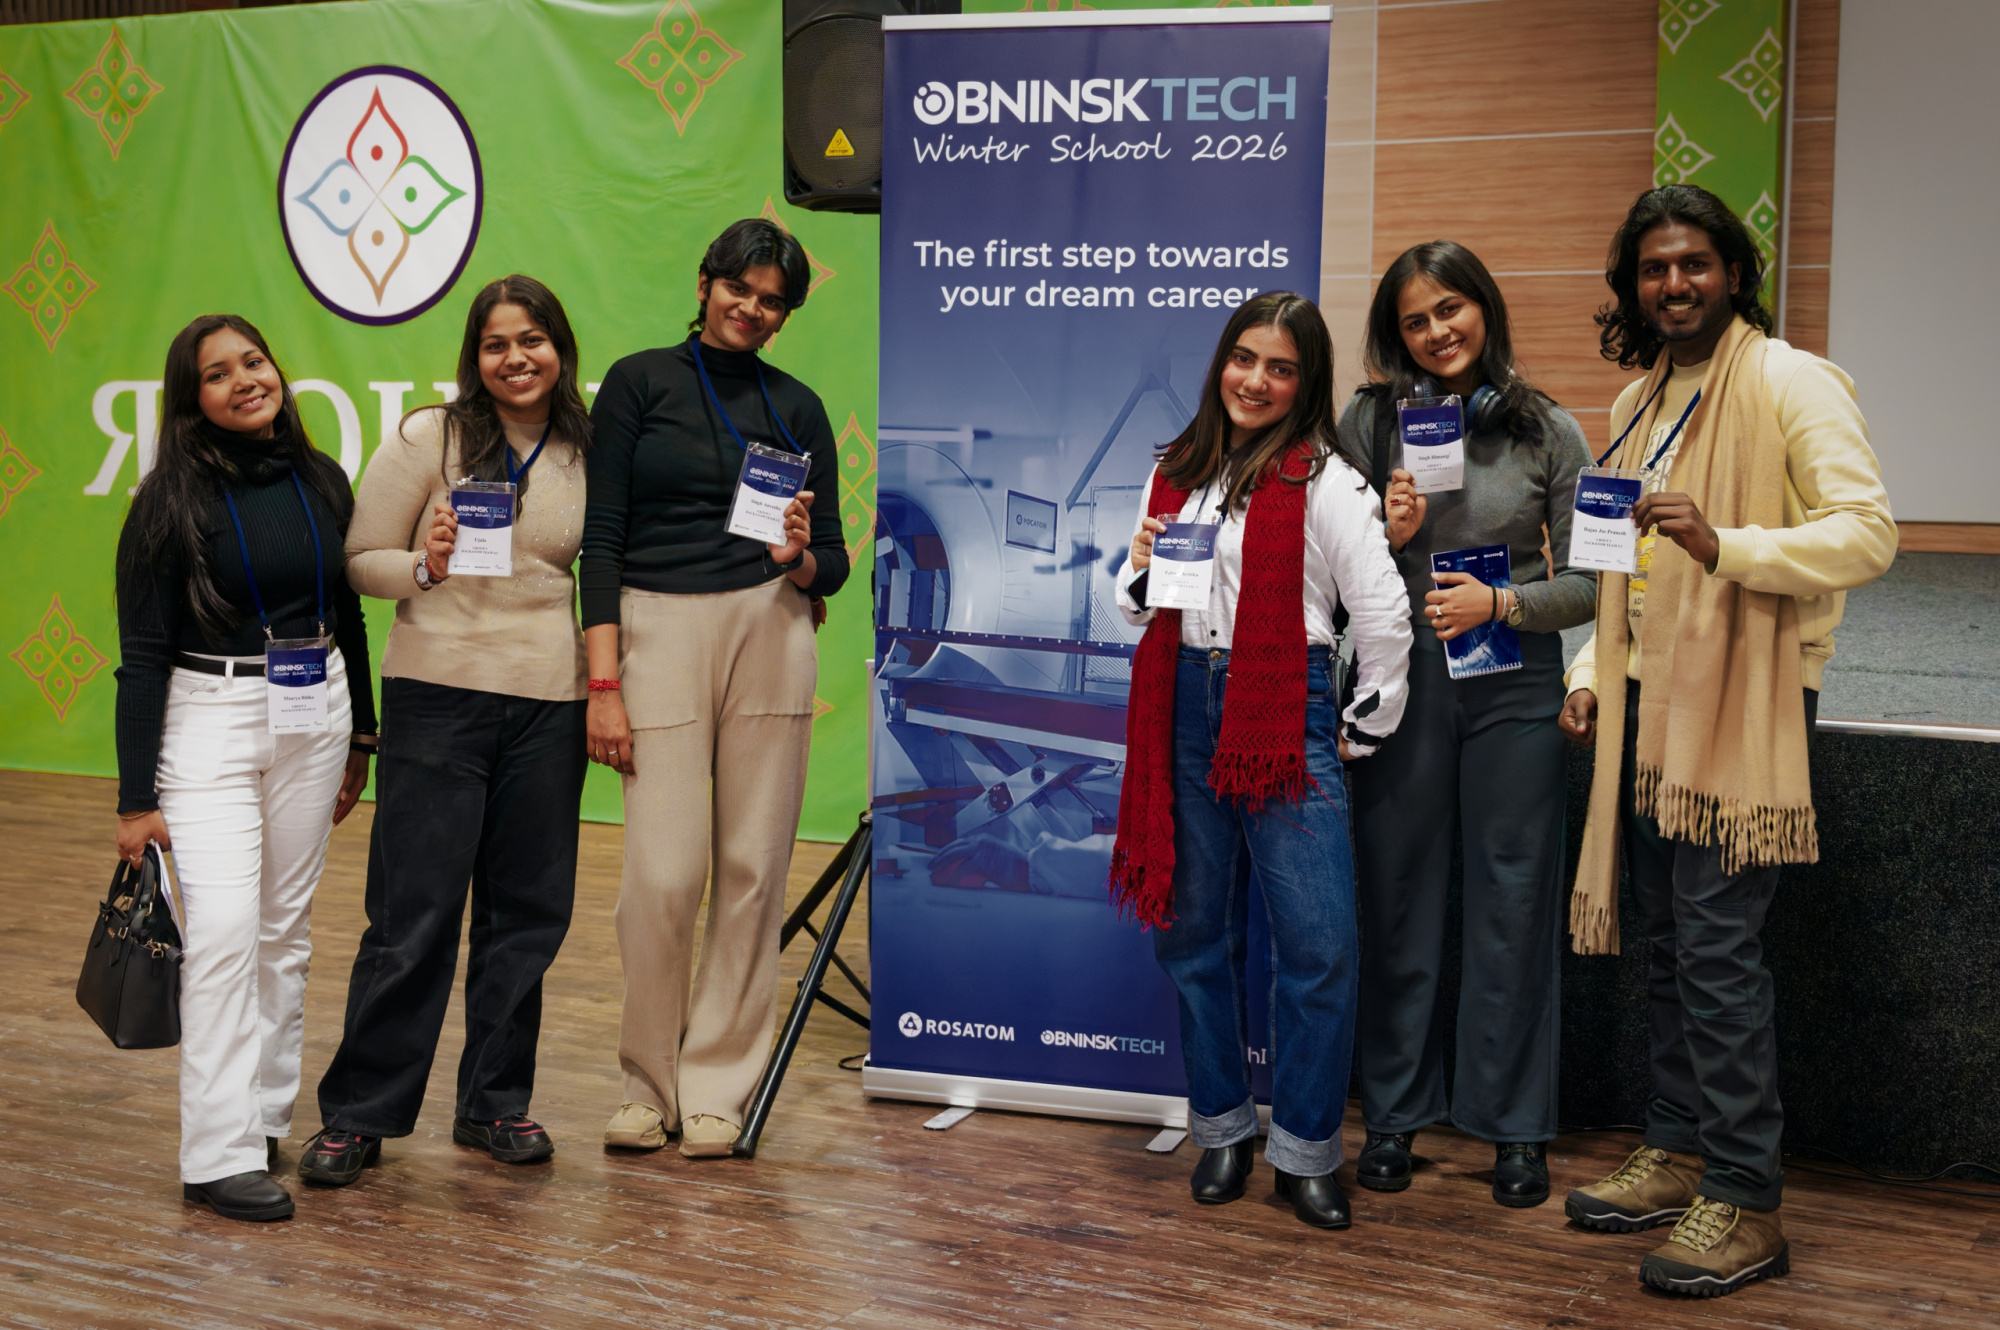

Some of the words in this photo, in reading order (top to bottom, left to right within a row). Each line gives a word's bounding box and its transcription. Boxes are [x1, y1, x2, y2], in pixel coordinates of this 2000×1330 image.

[913, 76, 1297, 125] OBNINSKTECH
[913, 133, 1030, 163] Winter
[1050, 132, 1172, 163] School
[1191, 131, 1288, 162] 2026
[913, 240, 975, 268] The
[984, 239, 1053, 268] first
[1062, 243, 1136, 273] step
[1147, 240, 1289, 268] towards
[940, 284, 1016, 313] your
[1025, 280, 1135, 308] dream
[1147, 285, 1258, 308] career
[926, 1019, 1015, 1041] ROSATOM
[1040, 1030, 1165, 1055] OBNINSKTECH
